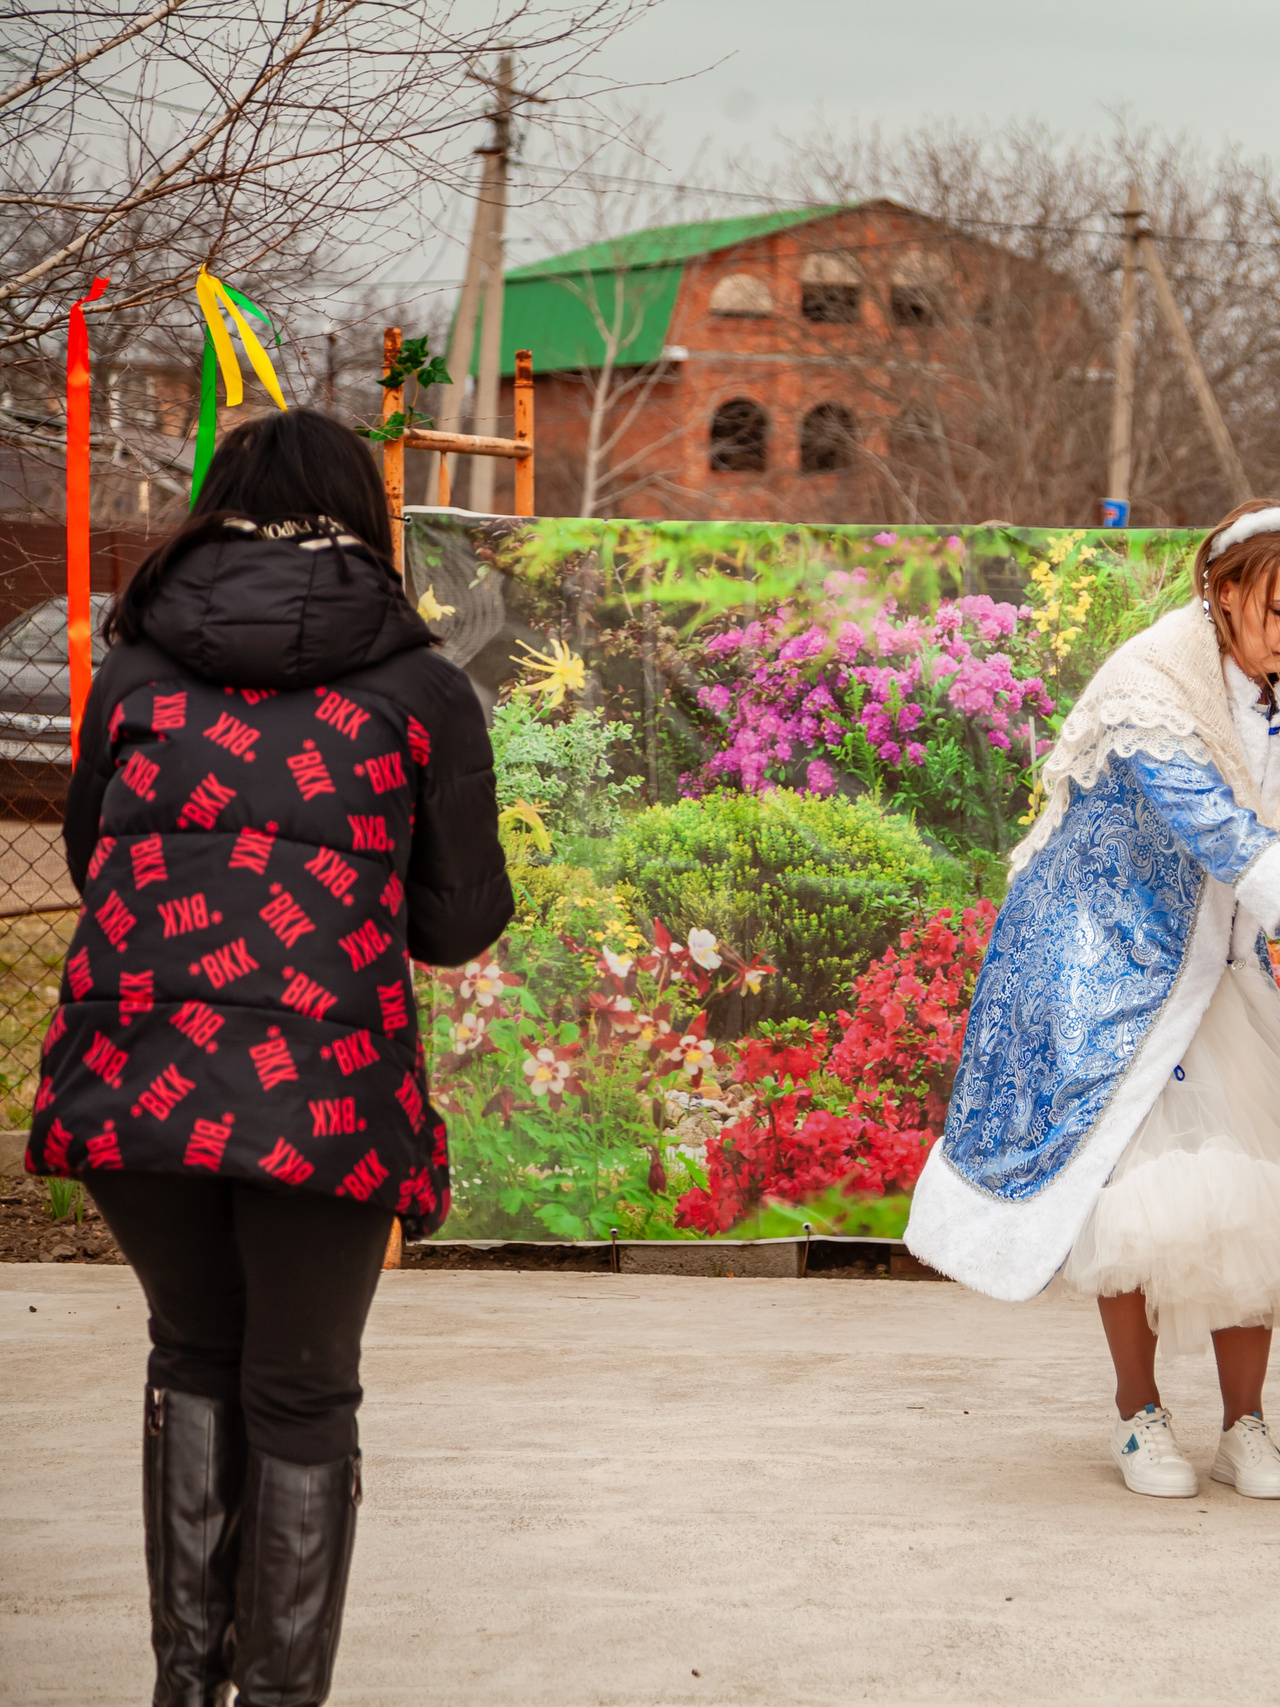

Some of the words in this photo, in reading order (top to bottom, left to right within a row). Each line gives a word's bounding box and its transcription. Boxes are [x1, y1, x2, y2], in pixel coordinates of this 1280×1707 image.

[150, 691, 188, 732] BKK
[202, 710, 261, 757] BKK
[314, 690, 371, 741] BKK
[285, 749, 337, 801] BKK
[363, 751, 407, 795] BKK
[181, 771, 238, 830] BKK
[129, 837, 169, 891] BKK
[303, 844, 360, 899] BKK
[94, 889, 138, 946] BKK
[156, 892, 210, 939] BKK
[258, 891, 317, 950] BKK
[199, 936, 260, 990] BKK
[338, 919, 386, 972] BKK
[280, 971, 339, 1023] BKK
[376, 979, 409, 1032] BKK
[82, 1031, 130, 1084] BKK
[248, 1031, 300, 1091] BKK
[331, 1028, 380, 1076] BKK
[137, 1062, 197, 1122] BKK
[307, 1096, 357, 1138] BKK
[183, 1117, 233, 1172] BKK
[342, 1148, 390, 1201] BKK
